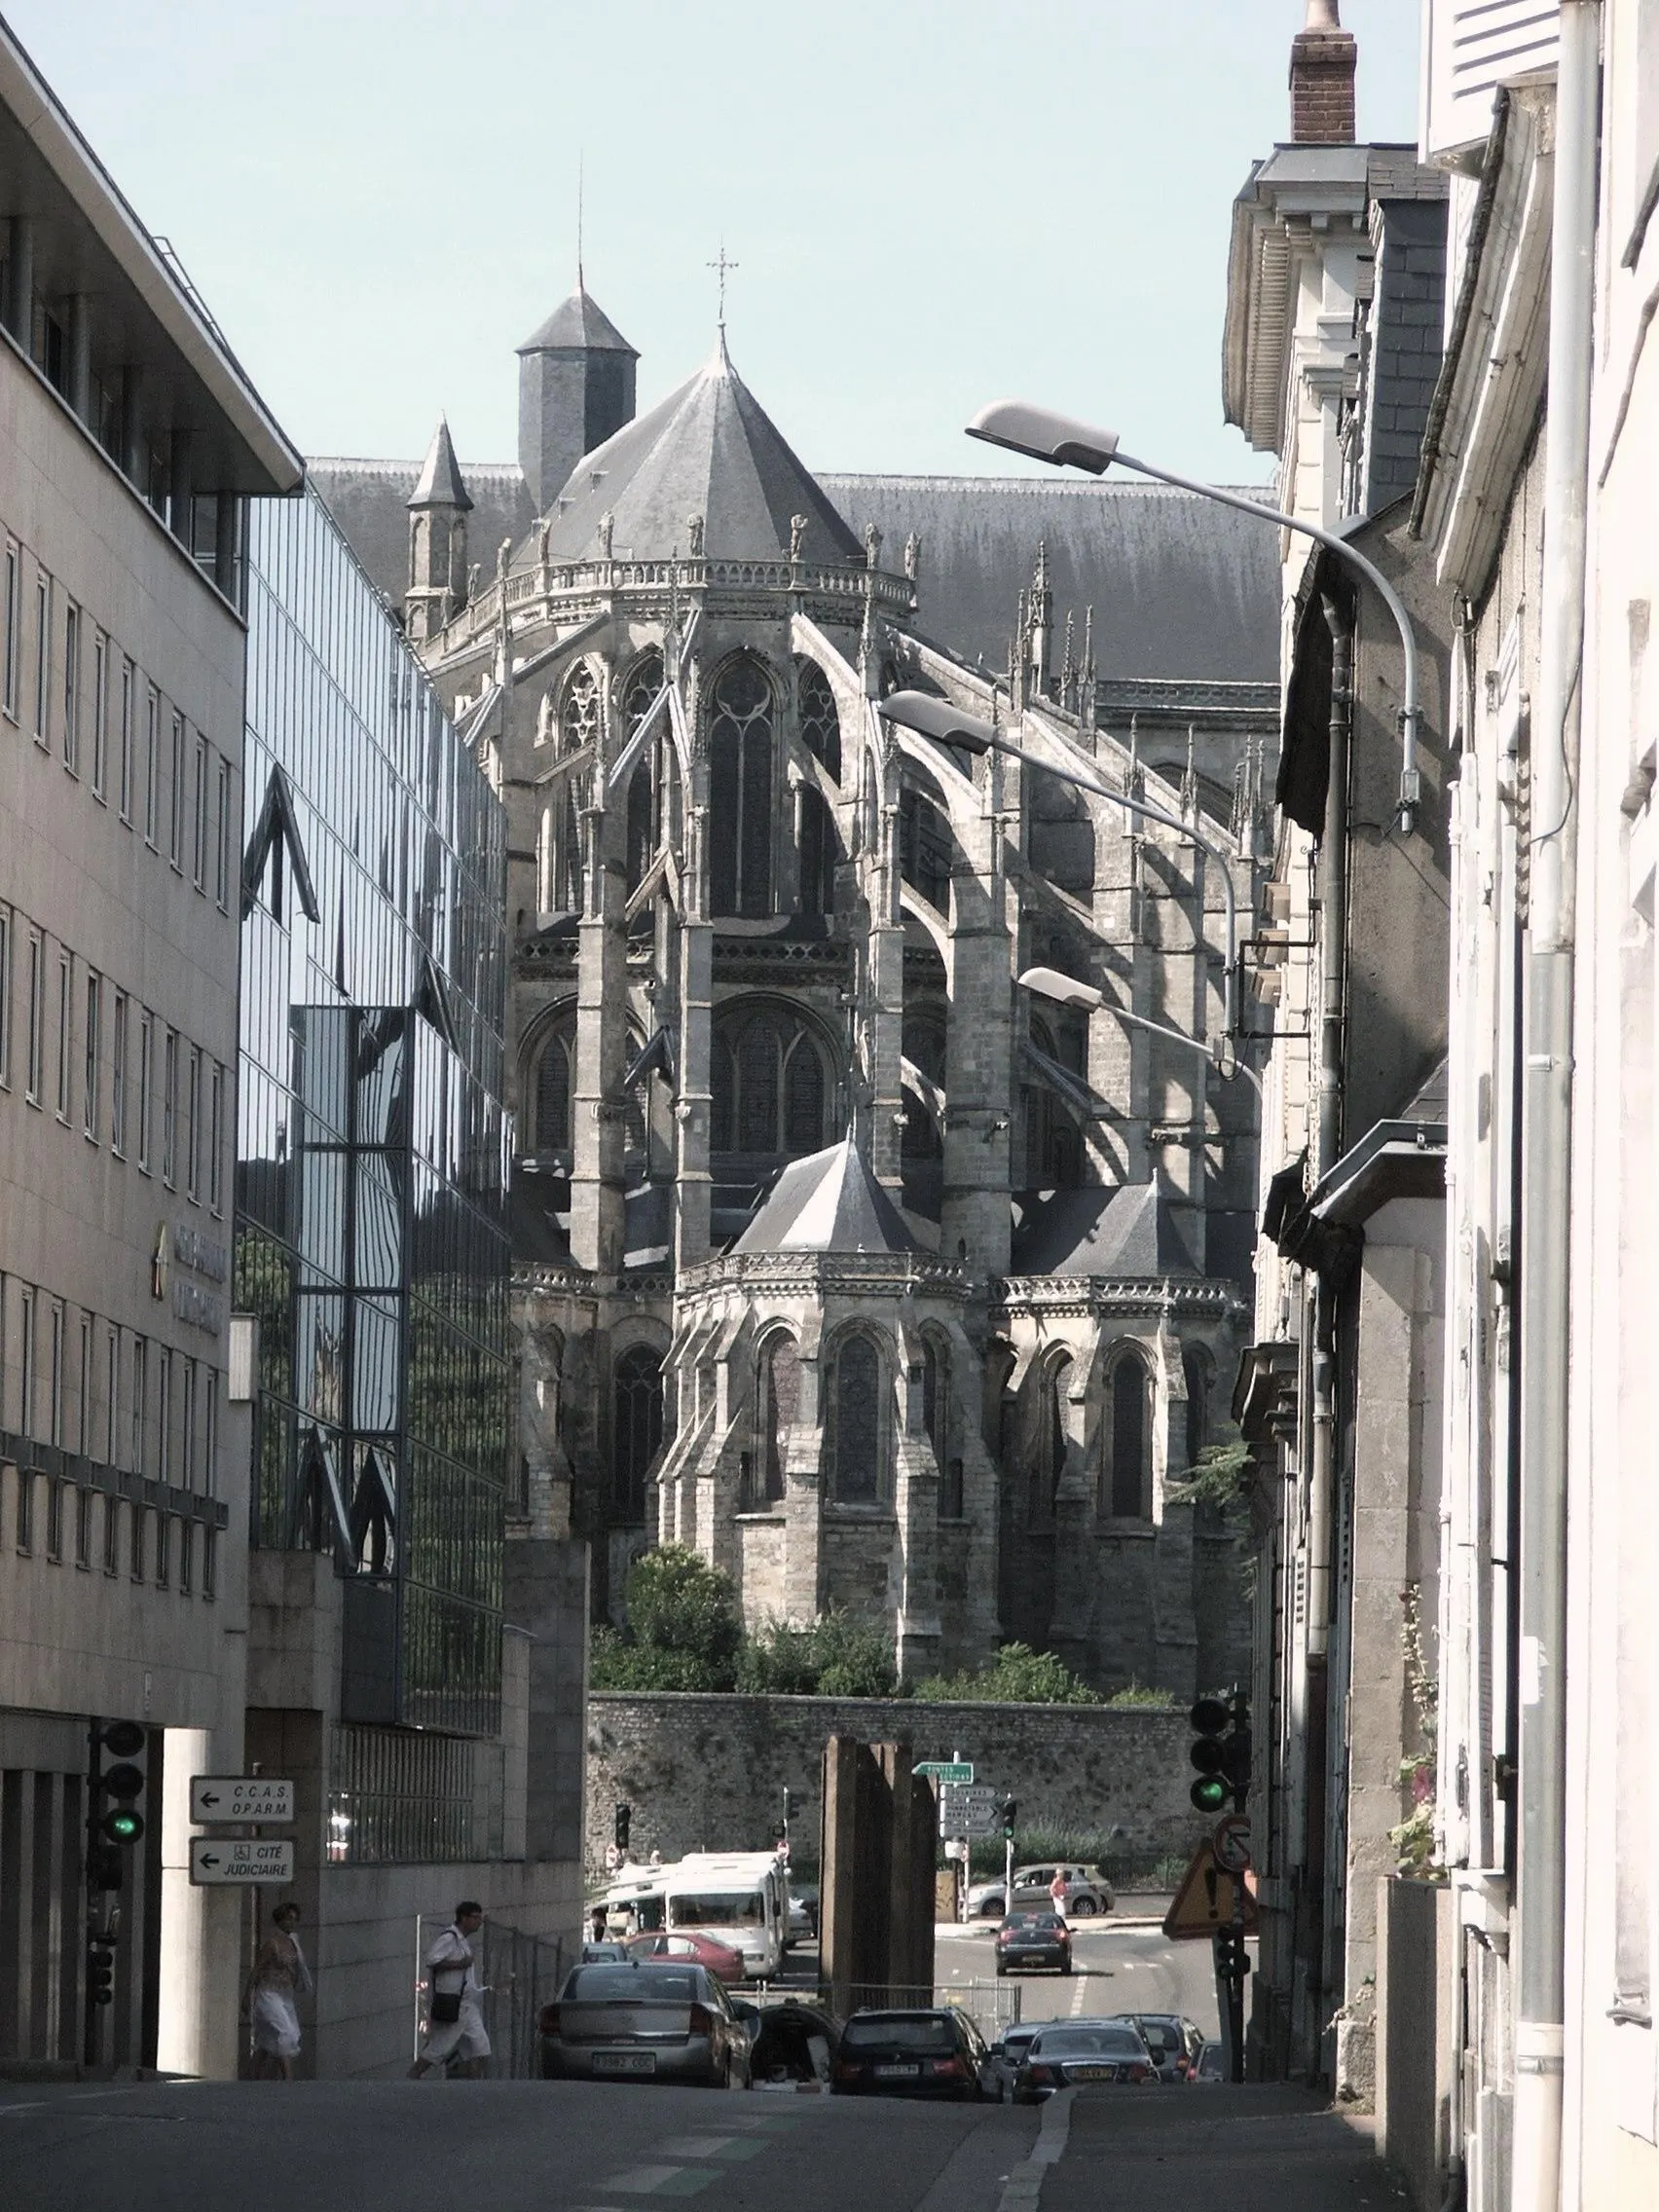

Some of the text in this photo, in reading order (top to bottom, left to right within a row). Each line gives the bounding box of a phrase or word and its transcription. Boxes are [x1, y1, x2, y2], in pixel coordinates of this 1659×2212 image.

[234, 1785, 289, 1798] C.C.A.S.
[257, 1845, 282, 1859] CITÉ
[223, 1862, 288, 1876] JUDICIAIRE
